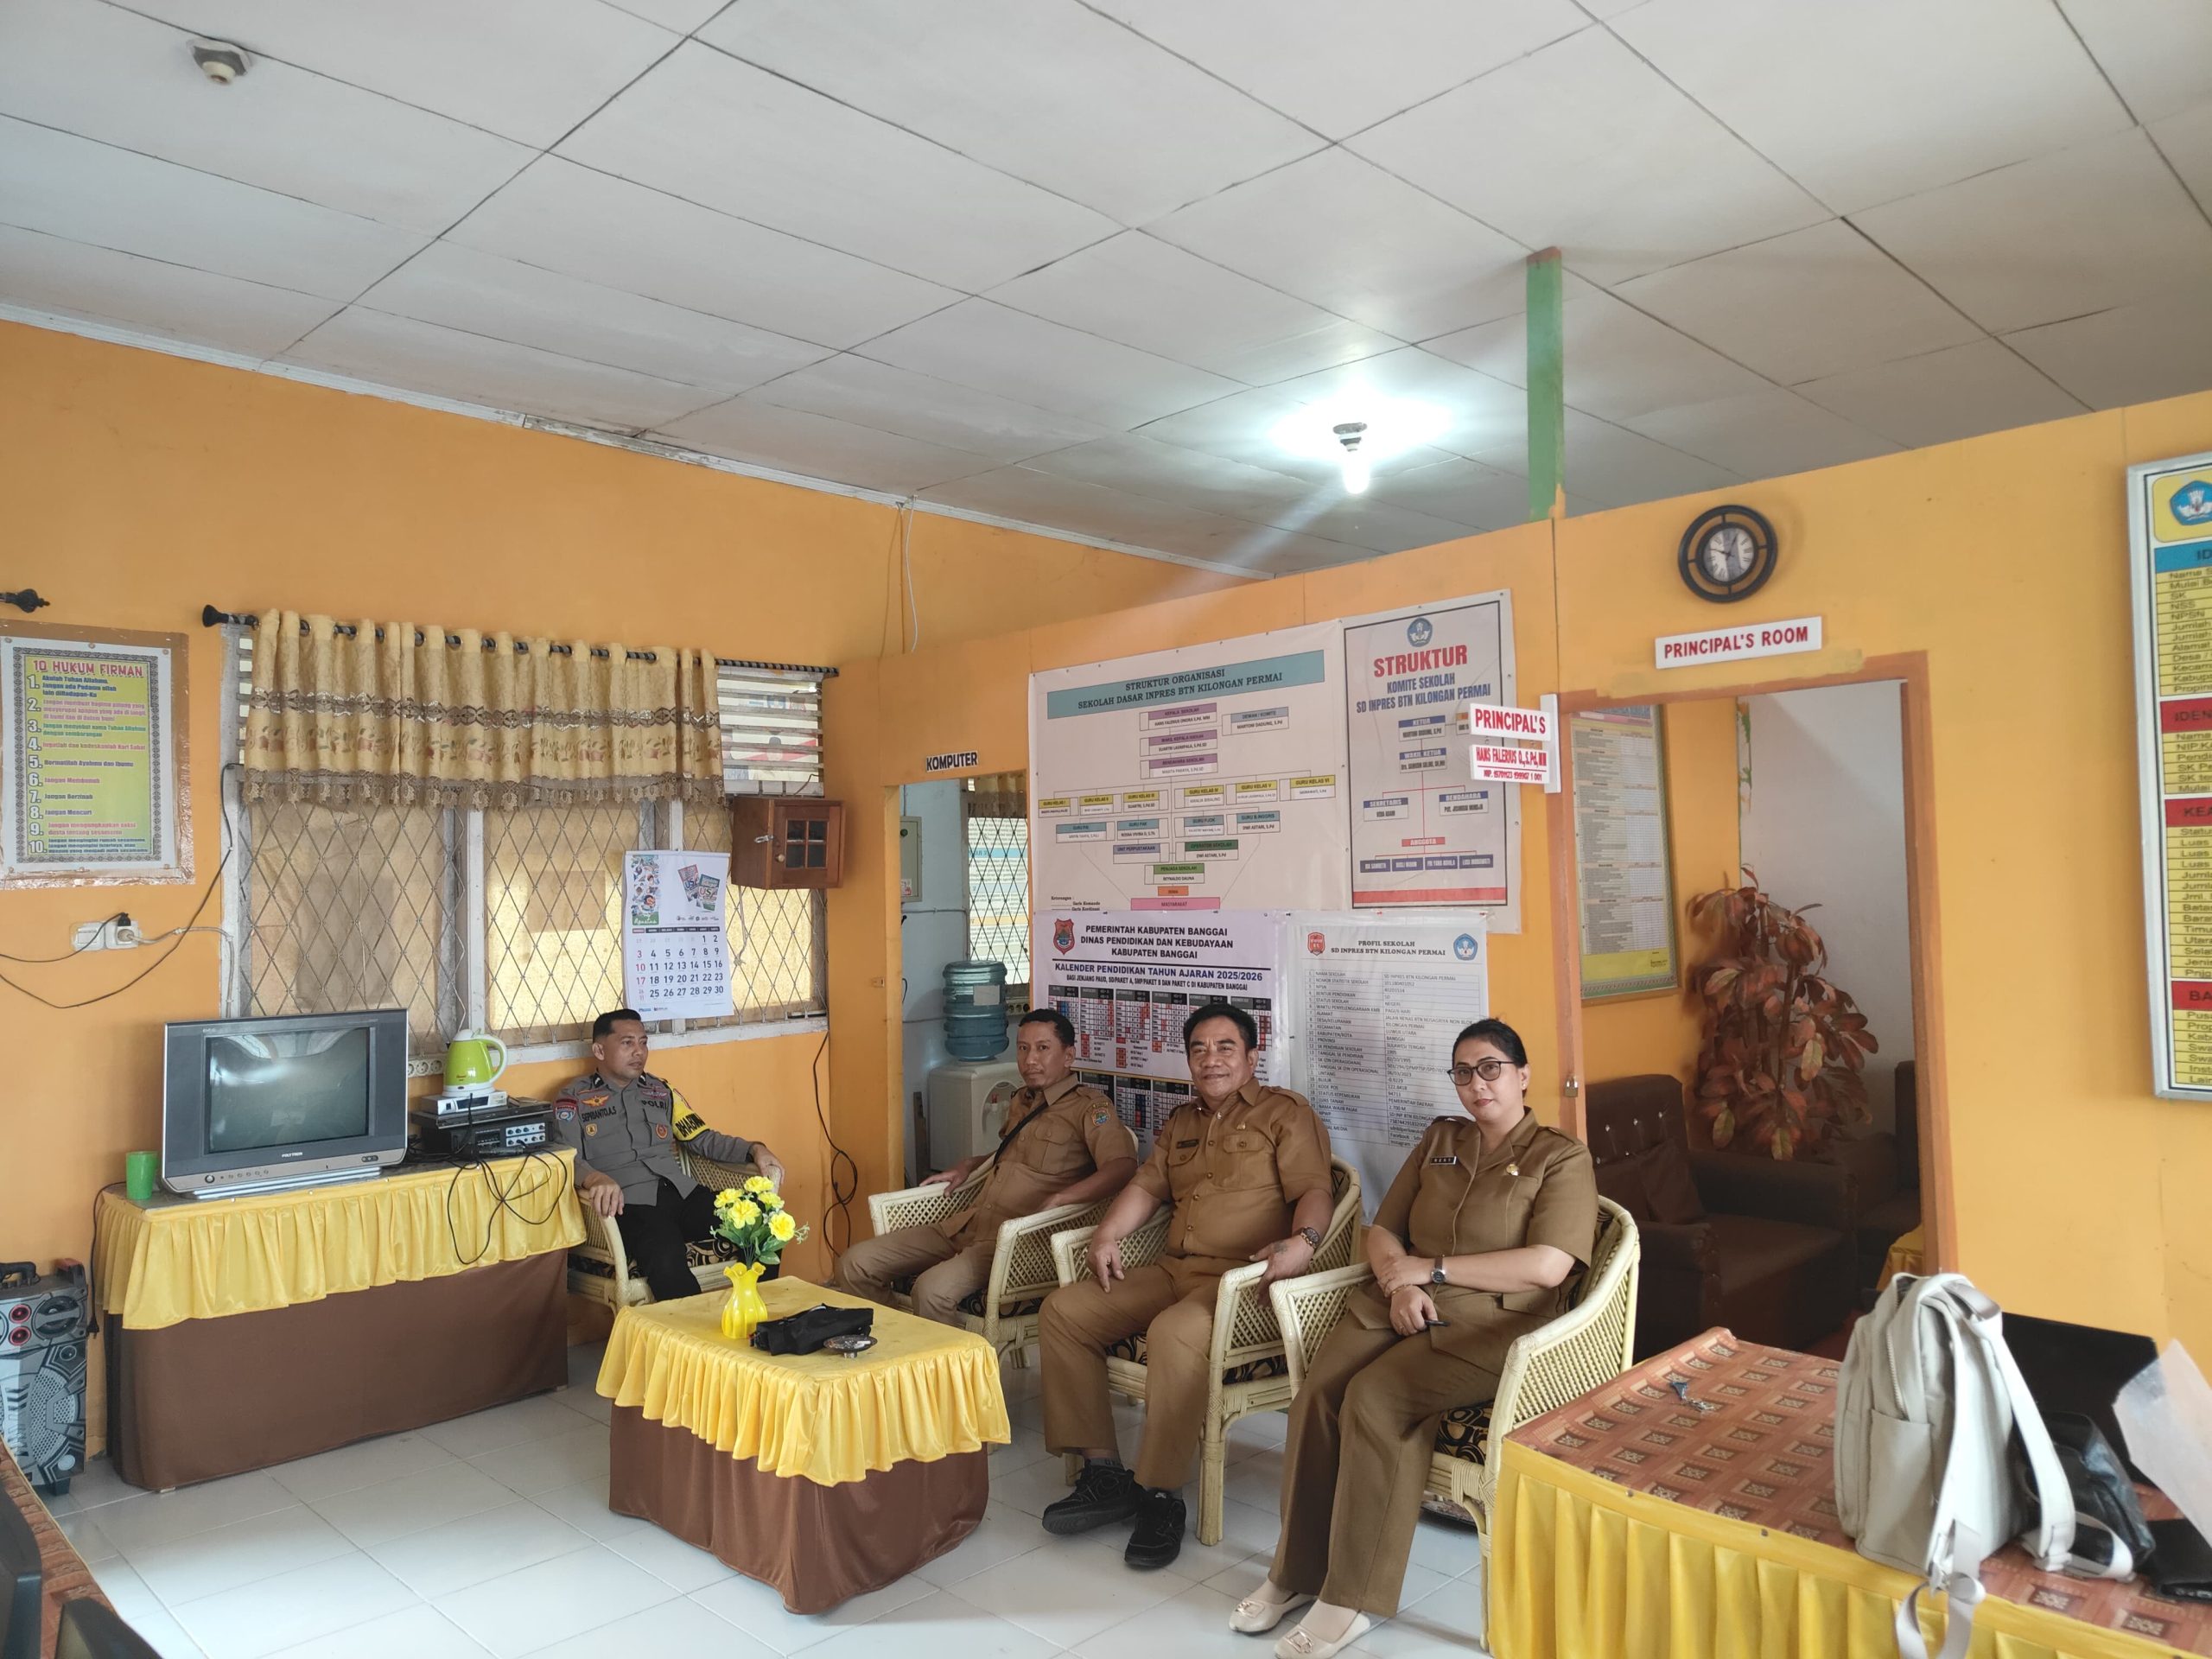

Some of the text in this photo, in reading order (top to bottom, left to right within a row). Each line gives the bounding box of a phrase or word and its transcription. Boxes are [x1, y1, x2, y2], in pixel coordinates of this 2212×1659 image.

[1664, 626, 1808, 658] PRINCIPAL'S ROOM
[34, 660, 143, 676] 10 HUKUM FIRMAN
[1374, 645, 1467, 677] STRUKTUR
[27, 675, 40, 689] 1.
[1126, 669, 1225, 691] STRUKTUR ORGANISASI
[1387, 672, 1455, 694] KOMITE SEKOLAH
[1078, 672, 1282, 709] SEKOLAH DASAR INPRES BTN KILONGAN PERMAI
[28, 697, 41, 711] 2.
[1357, 683, 1491, 713] SD INPRES BTN KILONGAN PERMAI
[28, 719, 41, 733] 3.
[1475, 709, 1546, 734] PRINCIPAL'S
[28, 737, 41, 751] 4.
[29, 754, 42, 768] 5.
[1476, 747, 1491, 761] HANS
[926, 752, 977, 771] KOMPUTER
[29, 772, 42, 787] 6.
[29, 790, 41, 803] 7.
[29, 805, 43, 819] 8.
[29, 822, 44, 836] 9.
[29, 840, 48, 854] 10.
[1085, 925, 1227, 936] PEMERINTAH KABUPATEN BANGGAI
[1106, 937, 1154, 945] PENDIDIKAN
[1175, 938, 1233, 948] KEBUDAYAAN
[637, 950, 642, 958] 3
[1111, 948, 1198, 958] KABUPATEN BANGGAI
[637, 976, 645, 985] 17
[702, 973, 712, 982] 22
[1055, 963, 1262, 981] KALENDER PENDIDIKAN TAHUN AJARAN 2025/2026
[664, 988, 674, 997] 26
[677, 988, 687, 996] 27
[690, 987, 700, 995] 28
[642, 1100, 667, 1110] POLRI
